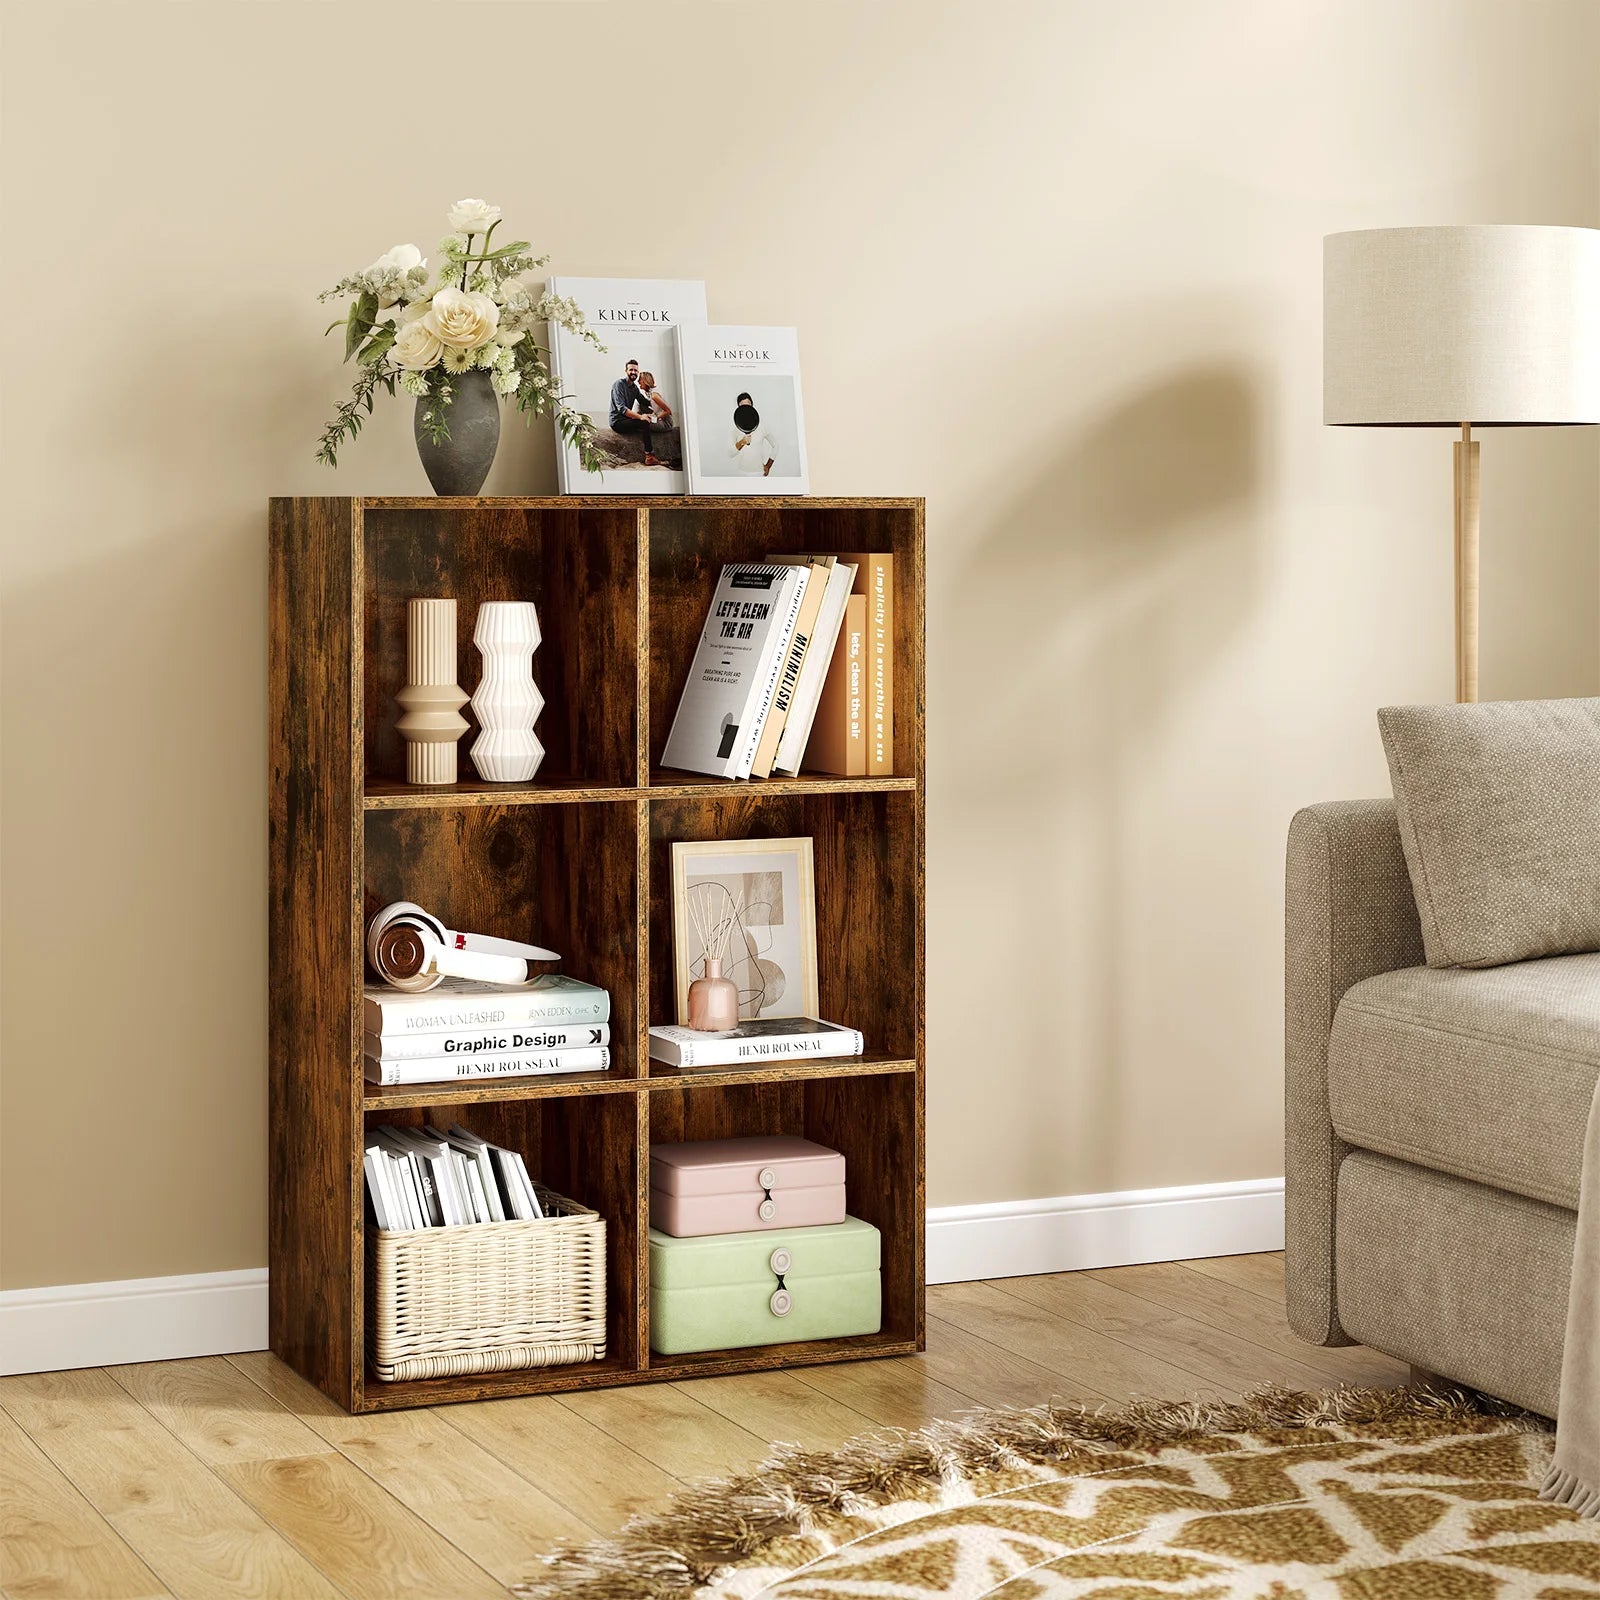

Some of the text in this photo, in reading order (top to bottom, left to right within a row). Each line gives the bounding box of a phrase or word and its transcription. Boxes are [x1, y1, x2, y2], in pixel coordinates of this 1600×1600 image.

[598, 309, 671, 322] KINFOLK
[714, 350, 770, 360] KINFOLK
[716, 601, 771, 620] LET'S CLEAN
[720, 621, 754, 639] THE AIR
[745, 580, 804, 765] simplicity is in everything we see
[775, 632, 808, 712] MINIMALISM
[874, 566, 885, 763] simplicity is in everything we see
[851, 632, 861, 740] lets, clean the air
[406, 1010, 505, 1029] WOMAN UNLEASHED
[528, 1008, 546, 1019] JENN
[444, 1032, 567, 1053] Graphic Design
[739, 1040, 823, 1057] HENRI ROUSSEAU
[457, 1057, 563, 1075] HENRI ROUSSEAU
